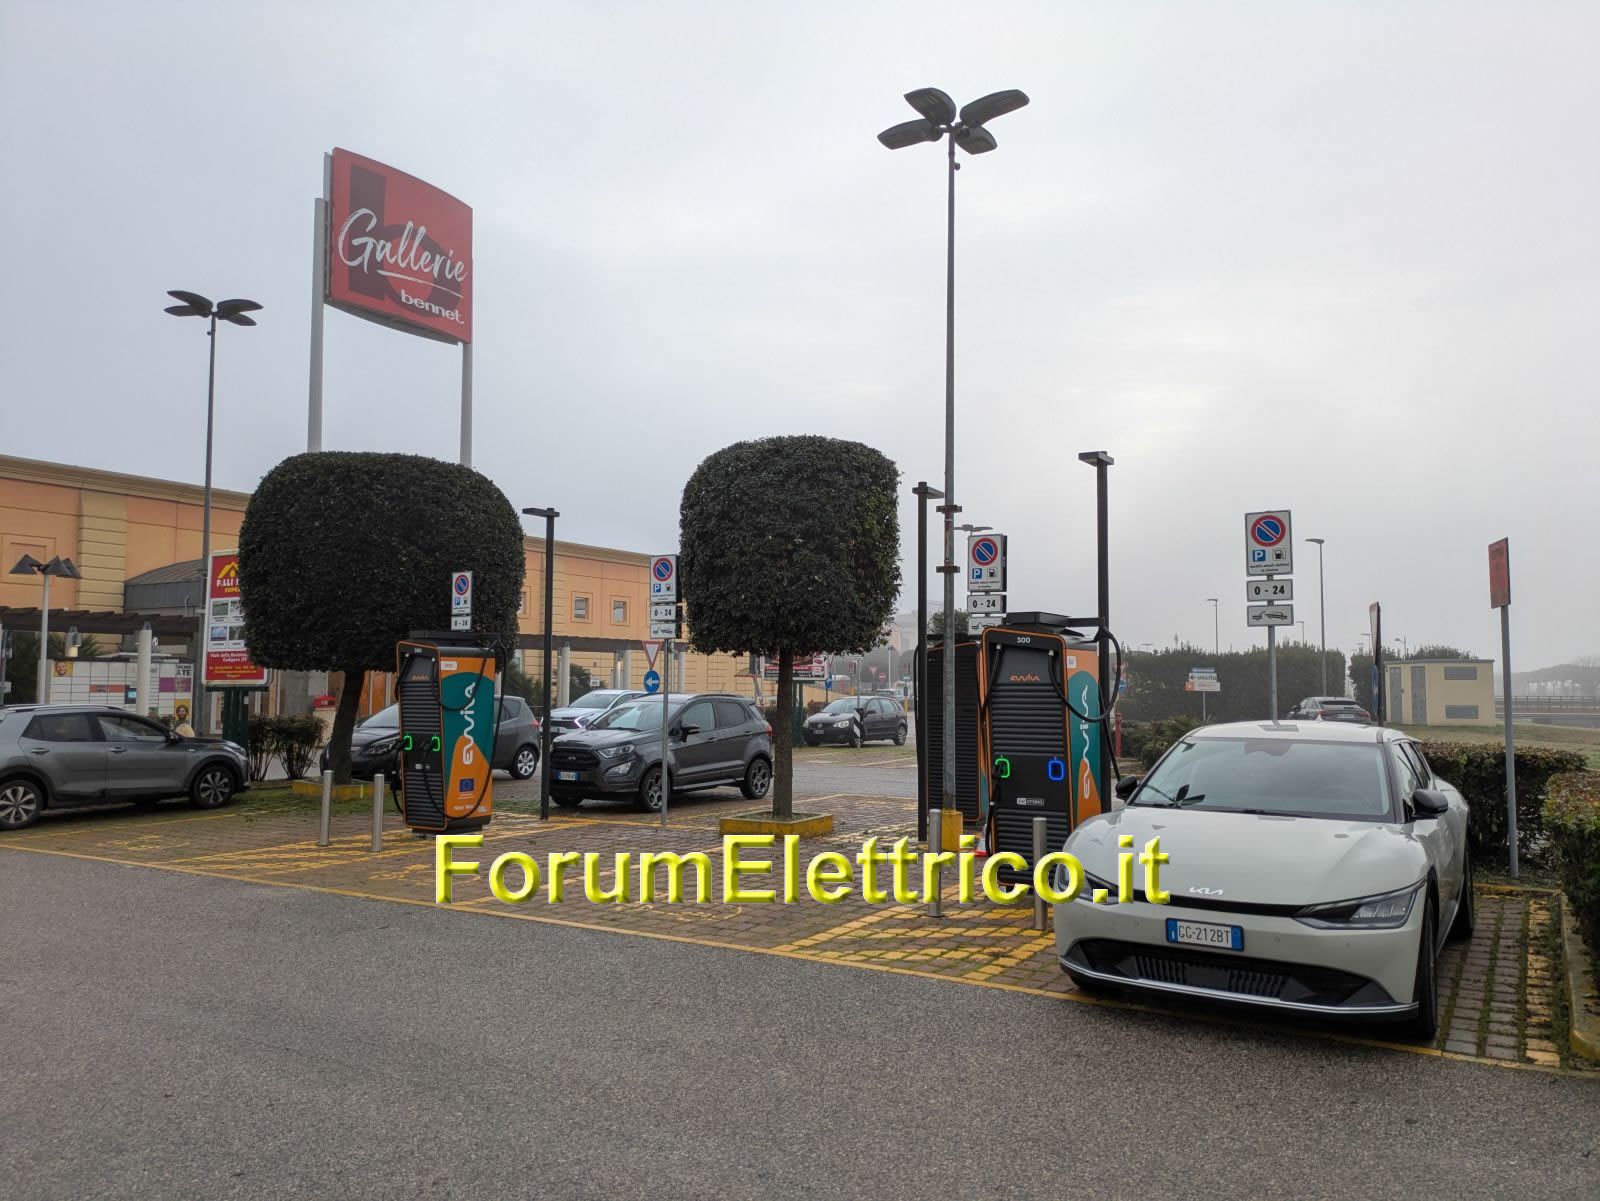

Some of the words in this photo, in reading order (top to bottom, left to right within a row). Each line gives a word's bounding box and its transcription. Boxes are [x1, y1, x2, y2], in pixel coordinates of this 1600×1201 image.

[337, 207, 469, 282] Gallerie
[400, 288, 465, 325] bennet
[1254, 585, 1261, 596] 0
[1272, 585, 1285, 595] 24
[972, 599, 978, 609] 0
[986, 599, 996, 608] 24
[664, 608, 672, 617] 24
[1016, 636, 1031, 644] 300
[1188, 887, 1224, 896] KIA
